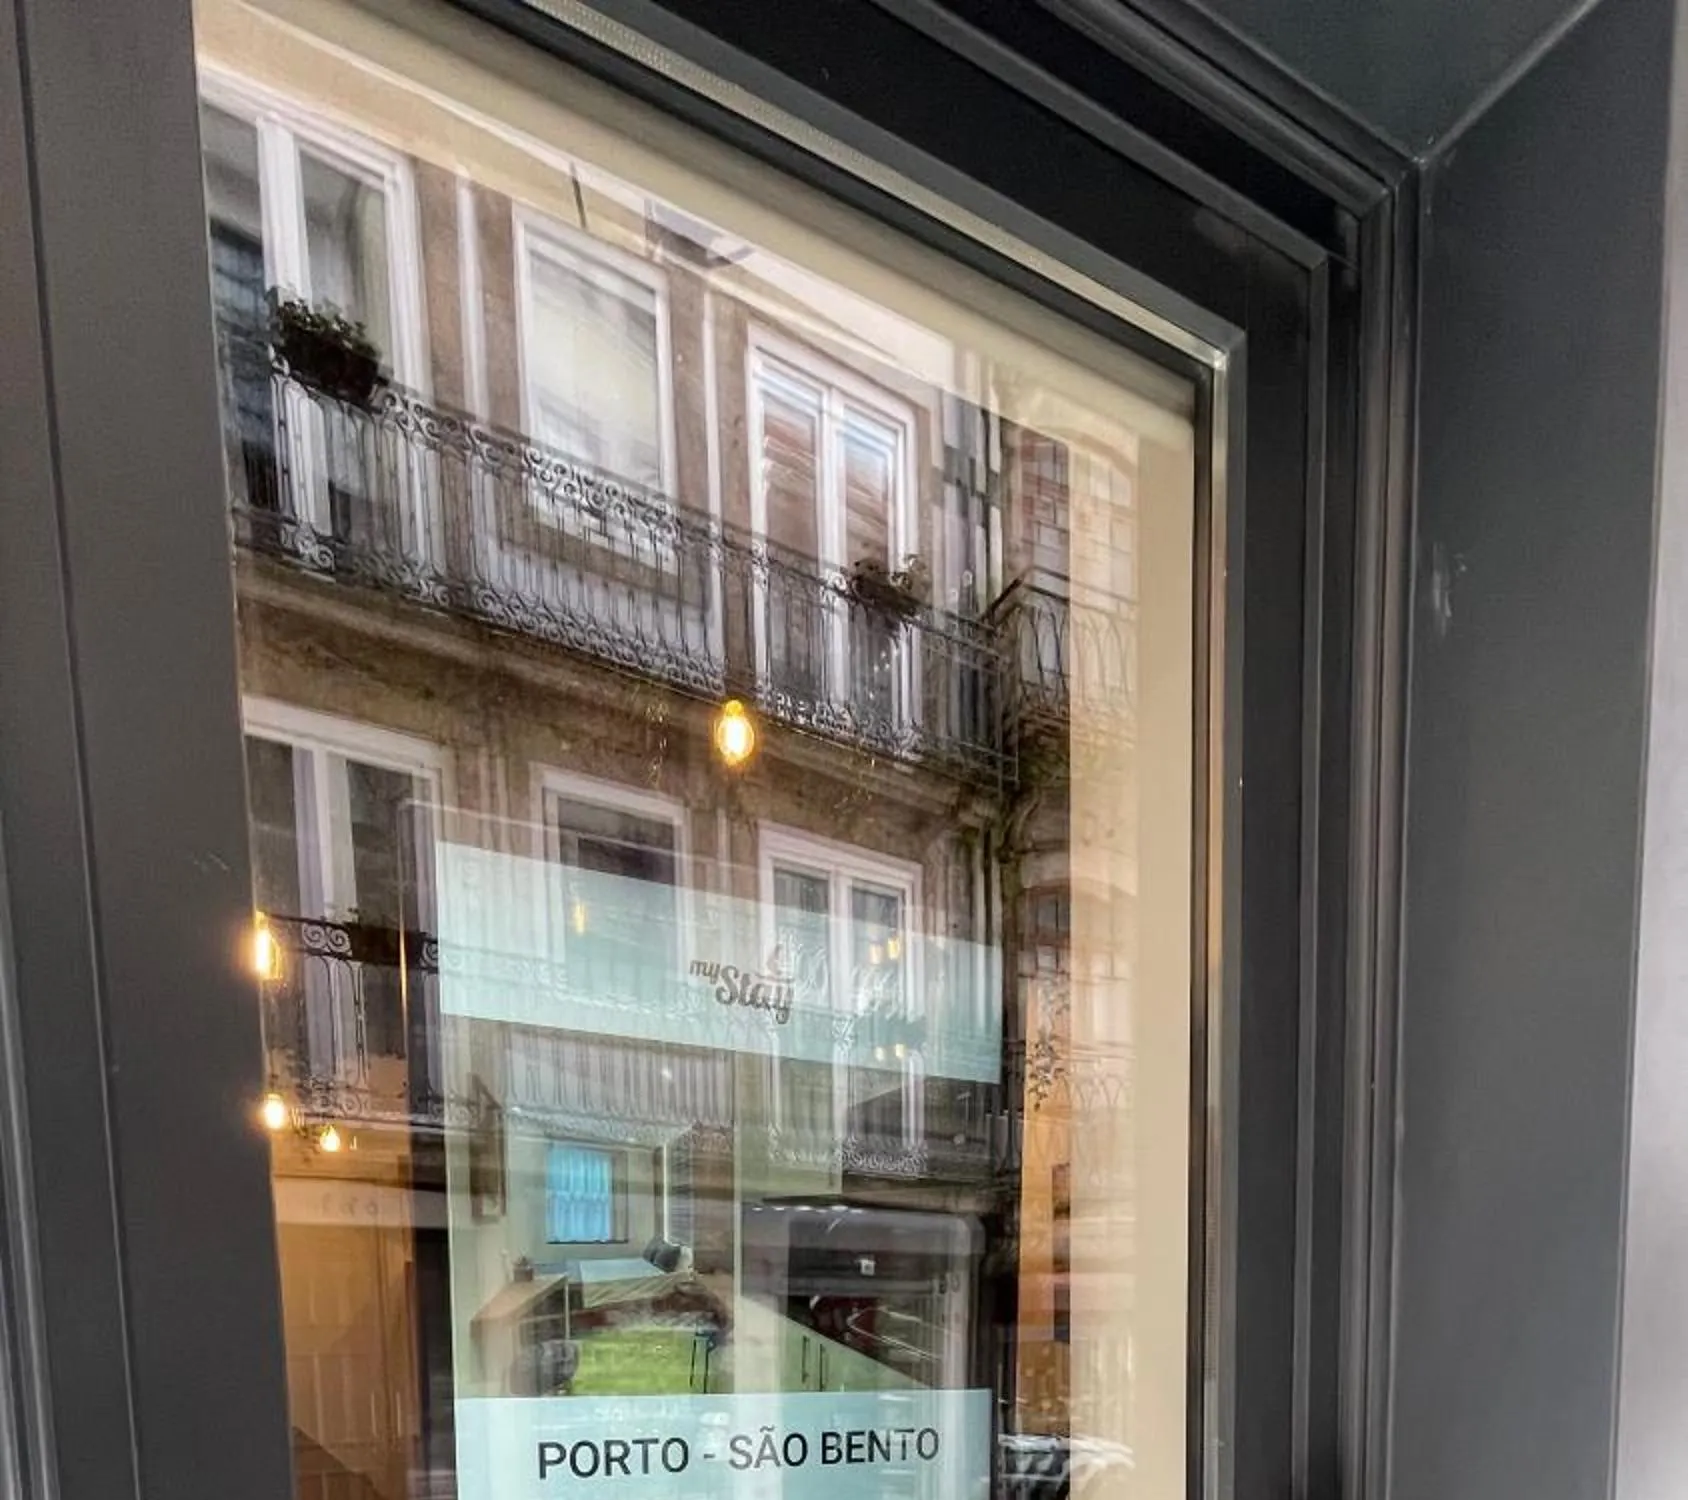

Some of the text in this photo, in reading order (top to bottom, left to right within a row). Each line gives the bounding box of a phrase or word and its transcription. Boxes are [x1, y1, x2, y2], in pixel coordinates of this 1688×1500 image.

[715, 963, 796, 1025] Stay
[537, 1436, 690, 1480] PORTO
[728, 1425, 808, 1471] SÃO
[821, 1427, 940, 1466] BENTO
